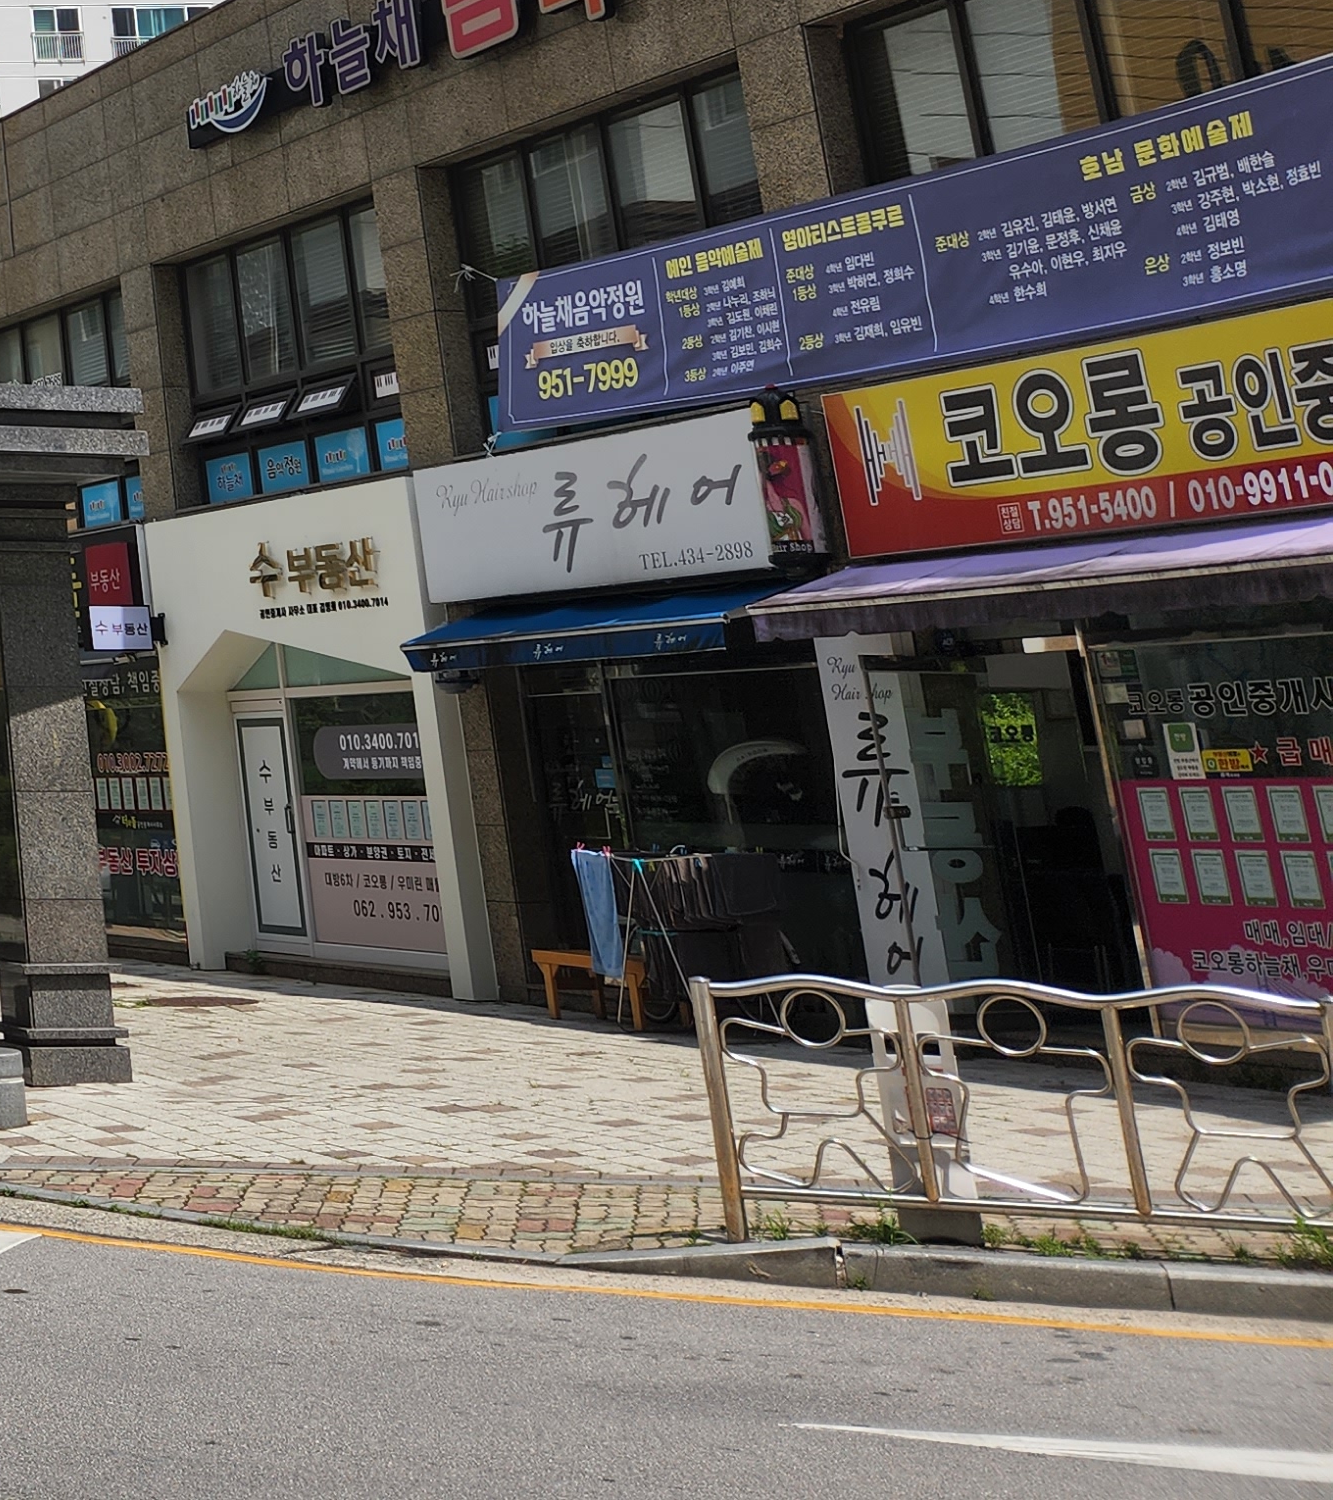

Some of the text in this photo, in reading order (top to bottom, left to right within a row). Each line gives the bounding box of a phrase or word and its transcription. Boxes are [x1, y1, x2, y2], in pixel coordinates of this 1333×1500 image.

[1079, 111, 1254, 181] 호남 문화예술제
[1130, 150, 1275, 204] 금상 2학년 김규범, 배한슬
[1171, 199, 1193, 214] 3학년
[1198, 185, 1239, 210] 강주현,
[1286, 160, 1321, 186] 정효빈
[782, 204, 905, 252] 영아티스트콩쿠르
[935, 196, 1118, 253] 준대상 2학년 김유진, 김태윤, 방서연
[1176, 209, 1241, 237] 4학년 김태영
[981, 219, 1123, 262] 3학년 김기윤, 문정후, 신채윤
[665, 238, 763, 279] 예인 음악예술제
[786, 264, 814, 284] 준대상
[844, 252, 875, 271] 임다빈
[1009, 241, 1128, 280] 유수아, 이현우, 최지우
[1144, 236, 1245, 275] 은상 2학년 정보빈
[1182, 260, 1248, 287] 3학년 홍소명
[665, 286, 697, 304] 학년대상
[792, 283, 817, 301] 1등상
[988, 281, 1047, 305] 4학년 한수희
[522, 280, 645, 334] 하늘채음악정원
[679, 302, 700, 318] 1등상
[550, 330, 620, 354] 입상을 축하합니다.
[682, 334, 703, 349] 2등상
[798, 332, 824, 351] 2등상
[890, 315, 923, 335] 임유빈
[538, 357, 639, 400] 951-7999
[684, 367, 706, 382] 3등상
[939, 339, 1333, 489] 코오롱 공인중
[266, 454, 302, 479] 음악정원
[217, 473, 243, 492] 하늘채
[1027, 485, 1157, 534] T.951-5400
[250, 537, 379, 599] 수 부동산
[639, 541, 753, 571] TEL.434-2898
[90, 568, 120, 593] 부동산
[95, 620, 149, 636] 수 부동산
[827, 656, 857, 680] Ryu
[831, 684, 861, 702] Hair
[1128, 688, 1184, 716] 코오롱
[314, 845, 412, 860] 아파트 상가 분양권 토지
[325, 872, 353, 888] 대방6차
[397, 876, 423, 892] 우미린
